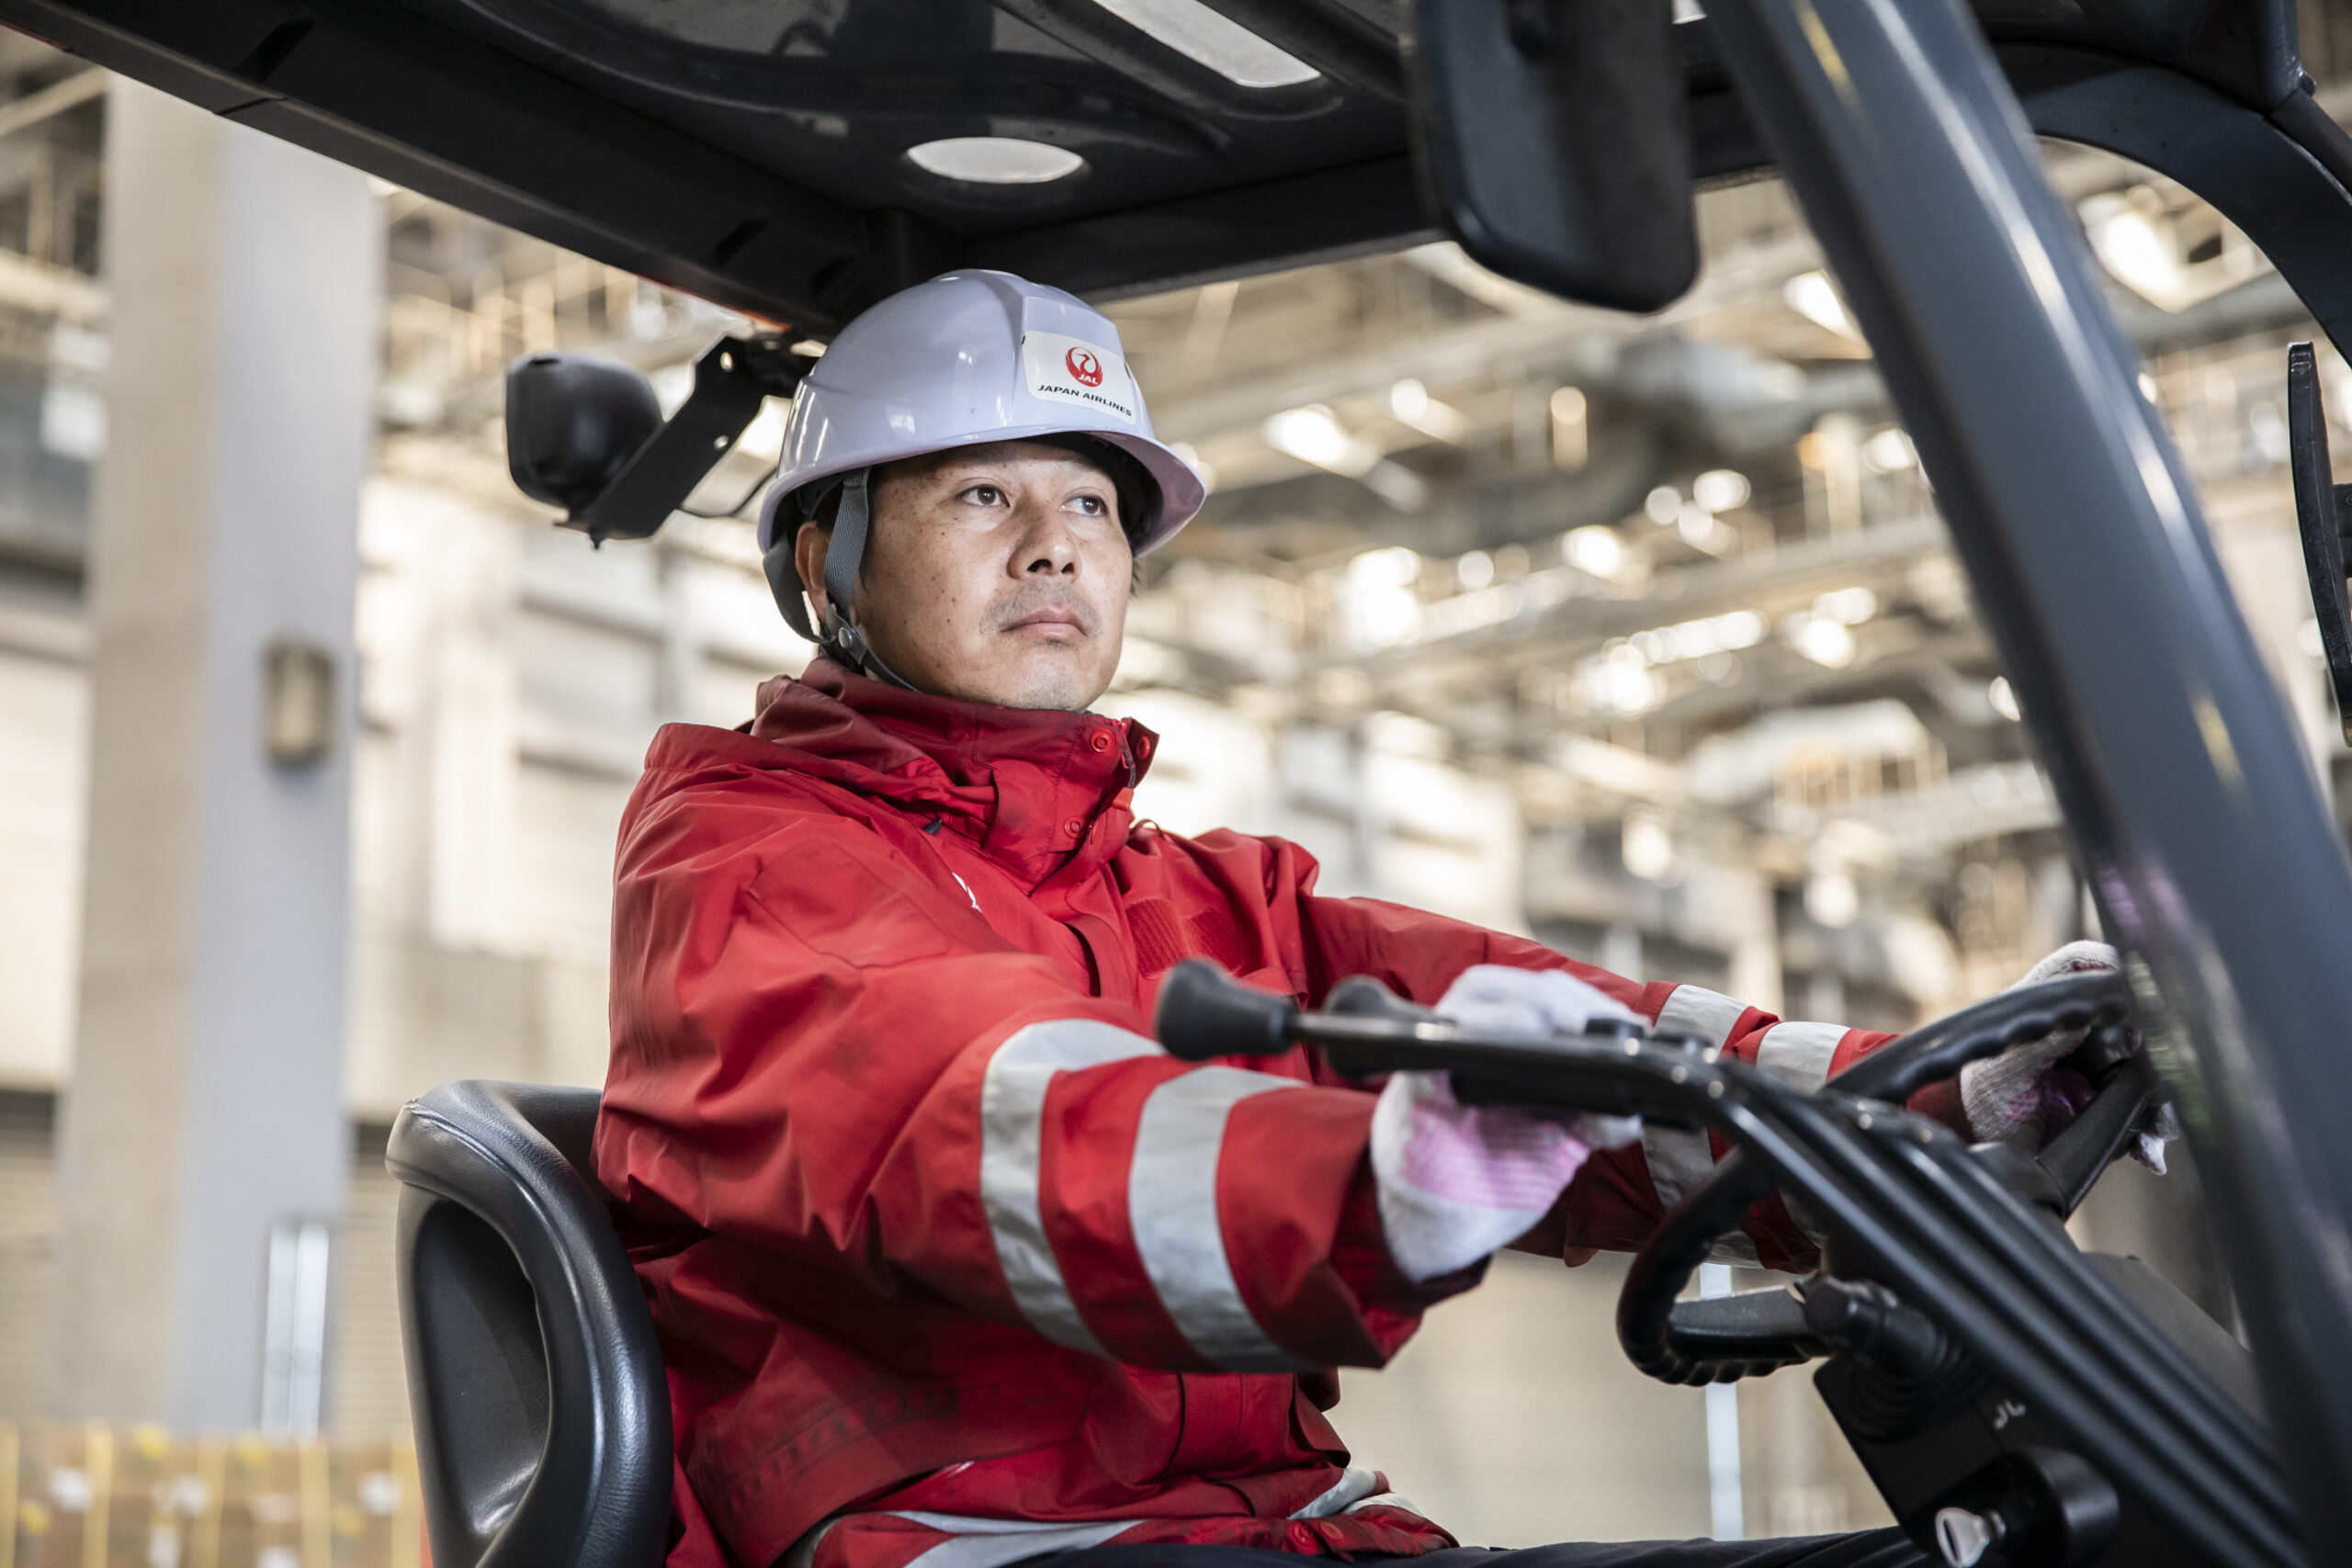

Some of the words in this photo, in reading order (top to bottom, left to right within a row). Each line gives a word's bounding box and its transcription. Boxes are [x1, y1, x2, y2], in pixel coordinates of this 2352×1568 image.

[1078, 374, 1099, 385] JAL
[1037, 384, 1080, 397] JAPAN
[1082, 392, 1132, 416] AIRLINES
